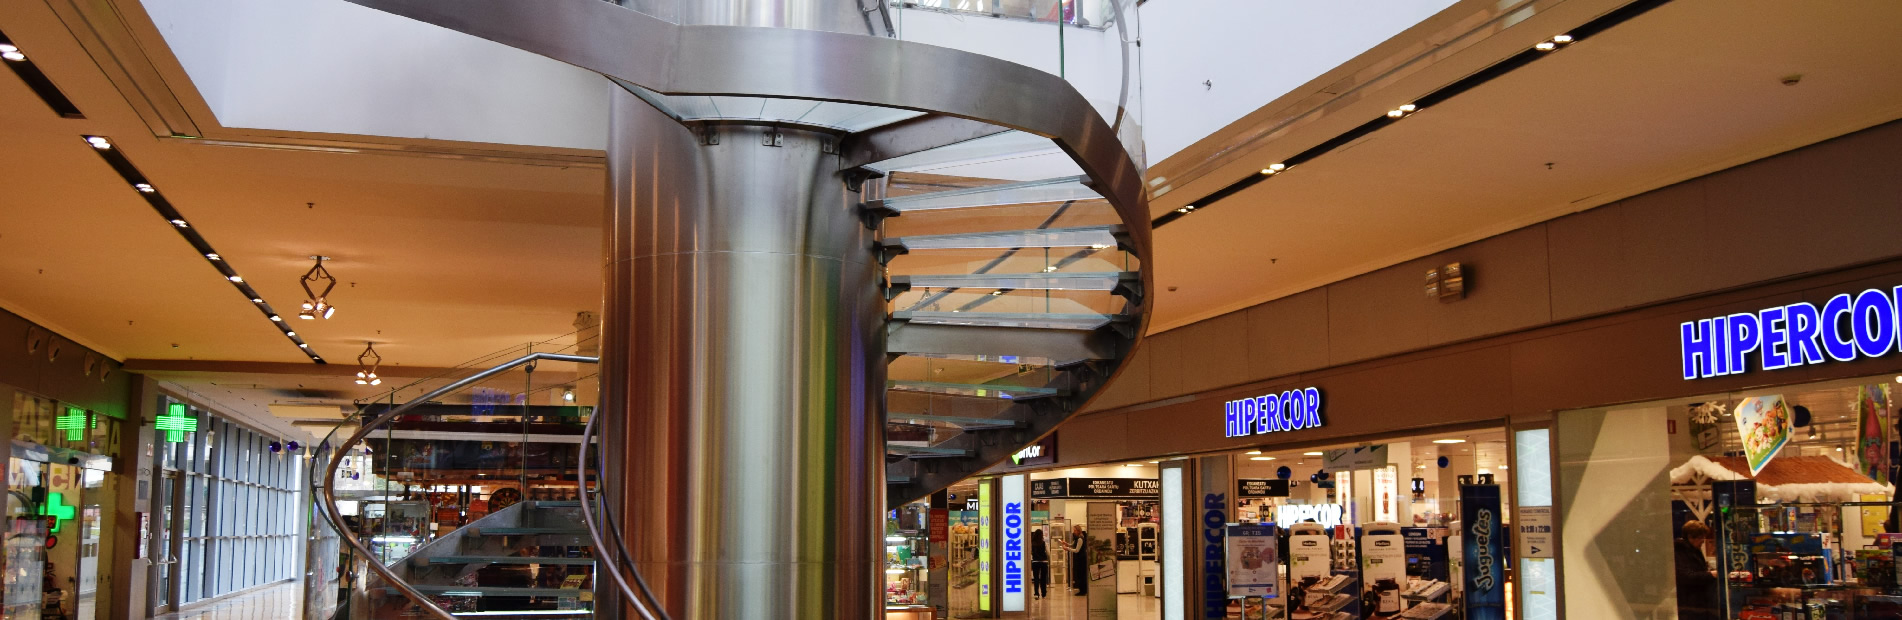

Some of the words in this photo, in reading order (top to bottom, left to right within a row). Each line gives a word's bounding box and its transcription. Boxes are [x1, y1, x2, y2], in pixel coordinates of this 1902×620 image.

[1680, 285, 1902, 380] HIPERCO
[1225, 386, 1321, 438] HIPERCOR
[1005, 502, 1022, 593] HIPERCOR
[1205, 493, 1226, 618] HIPERCOR
[1277, 503, 1342, 529] HIPERCOR
